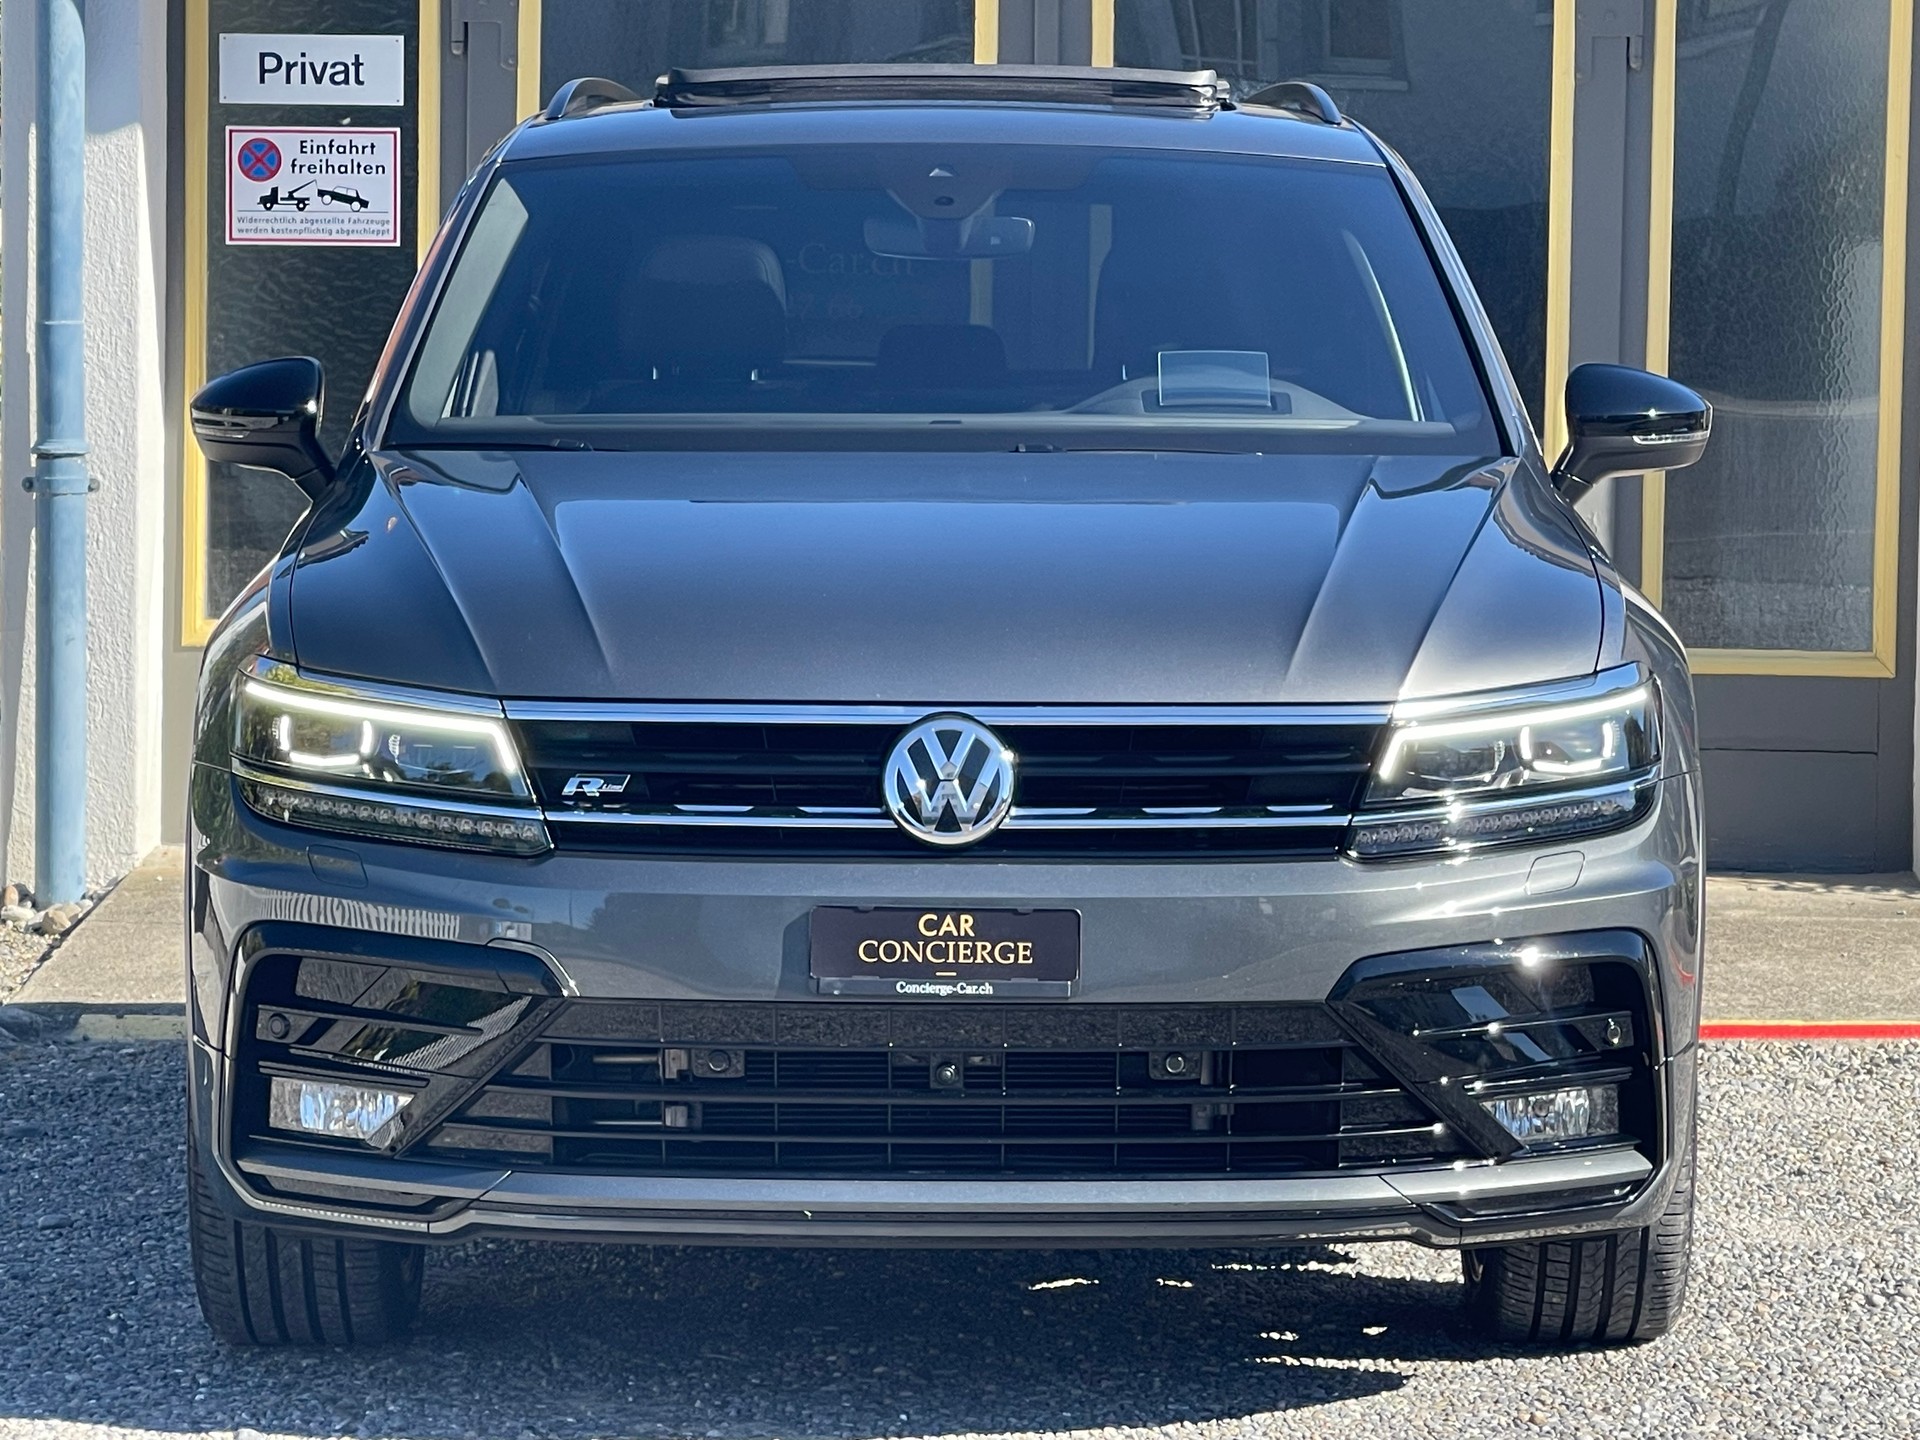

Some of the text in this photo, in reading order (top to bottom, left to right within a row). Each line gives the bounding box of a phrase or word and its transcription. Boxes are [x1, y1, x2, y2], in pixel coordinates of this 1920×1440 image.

[259, 52, 365, 86] Privat
[300, 139, 376, 155] Einfahrt
[290, 158, 386, 175] freihalten
[237, 216, 390, 227] Widerrechtlich abgestellte Fahrzeuge
[237, 226, 390, 237] werden kostenpflichtig abgeschleppt
[918, 913, 975, 938] CAR
[858, 939, 1033, 965] CONCIERGE
[896, 980, 994, 997] Concierge-Car.ch
